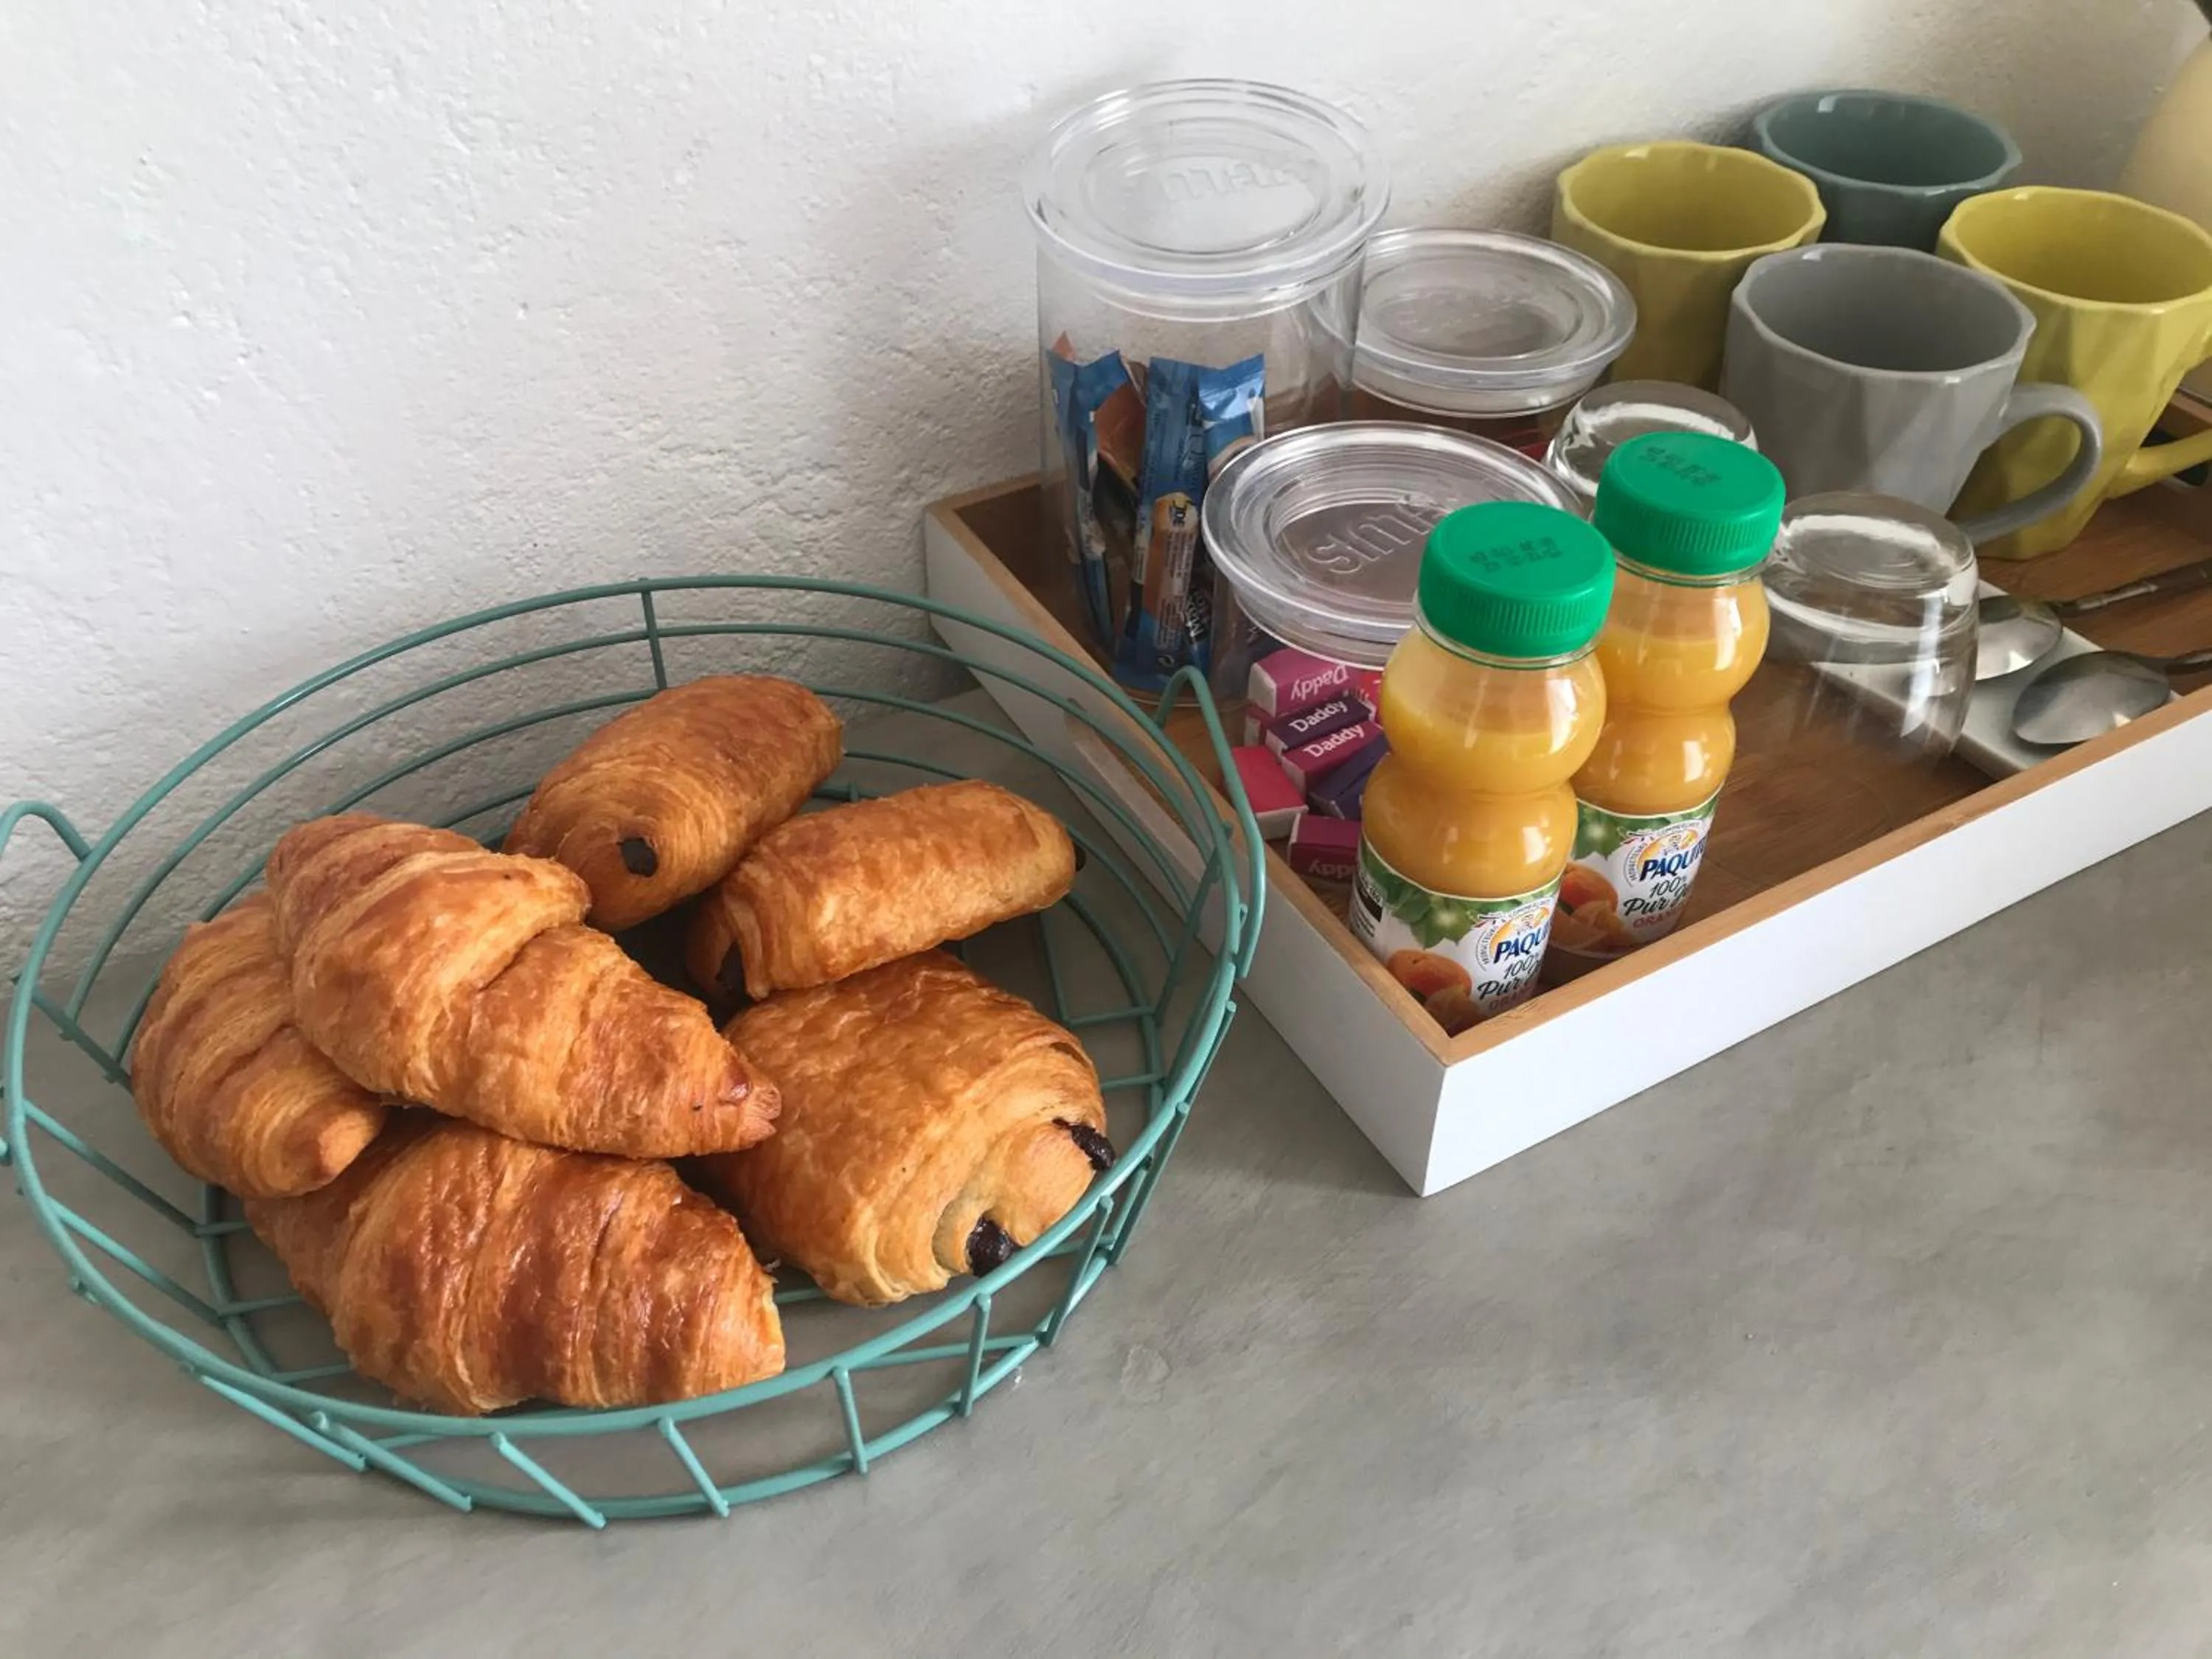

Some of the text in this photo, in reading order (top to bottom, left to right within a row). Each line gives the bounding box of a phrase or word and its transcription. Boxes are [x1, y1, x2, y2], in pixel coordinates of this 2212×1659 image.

[1290, 664, 1350, 700] Daddy
[1289, 699, 1349, 732] Daddy
[1303, 723, 1366, 758] Daddy
[1623, 897, 1670, 917] Pur
[1477, 977, 1521, 1001] Pur
